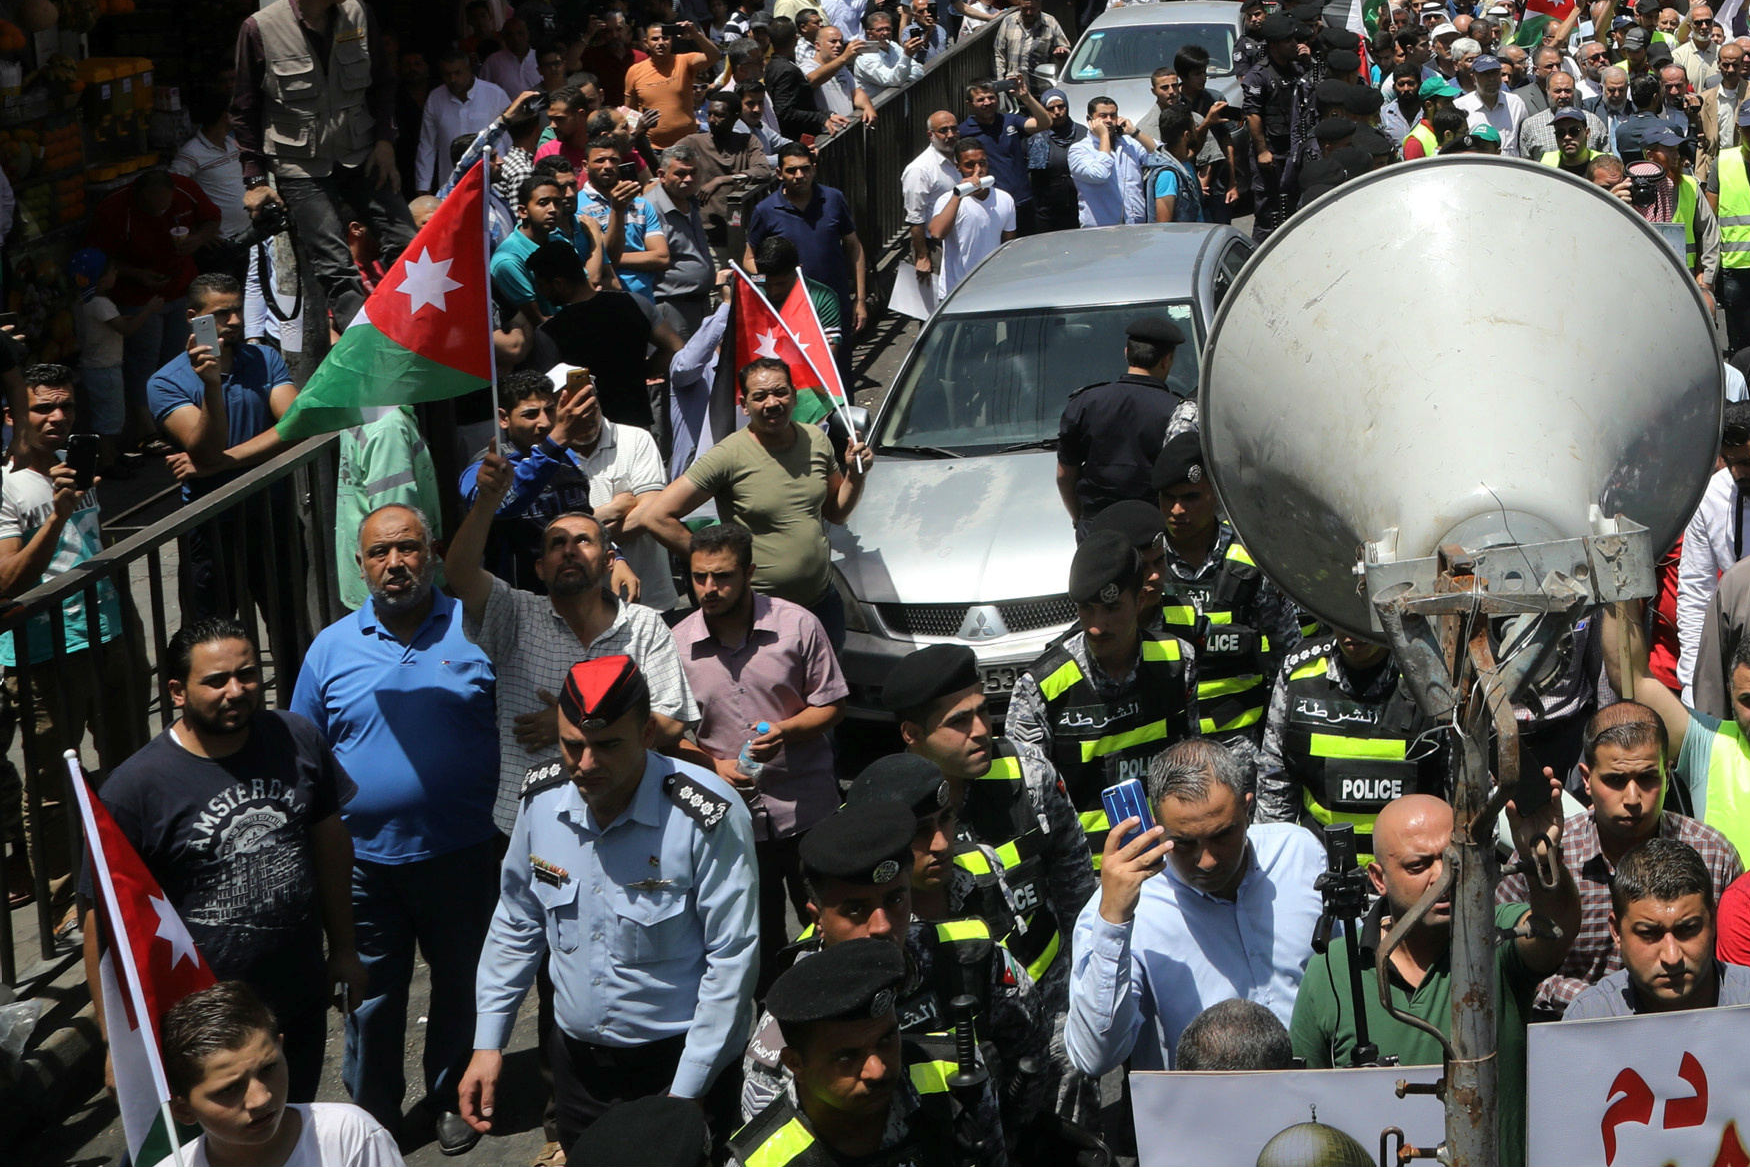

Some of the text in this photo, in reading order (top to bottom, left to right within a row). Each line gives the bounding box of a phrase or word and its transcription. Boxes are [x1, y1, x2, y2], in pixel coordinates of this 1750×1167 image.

[1206, 633, 1240, 652] LICE
[1058, 699, 1140, 728] الشرطة
[1296, 699, 1379, 725] الشرطة
[1342, 779, 1403, 801] POLICE
[1600, 1050, 1709, 1167] دم
